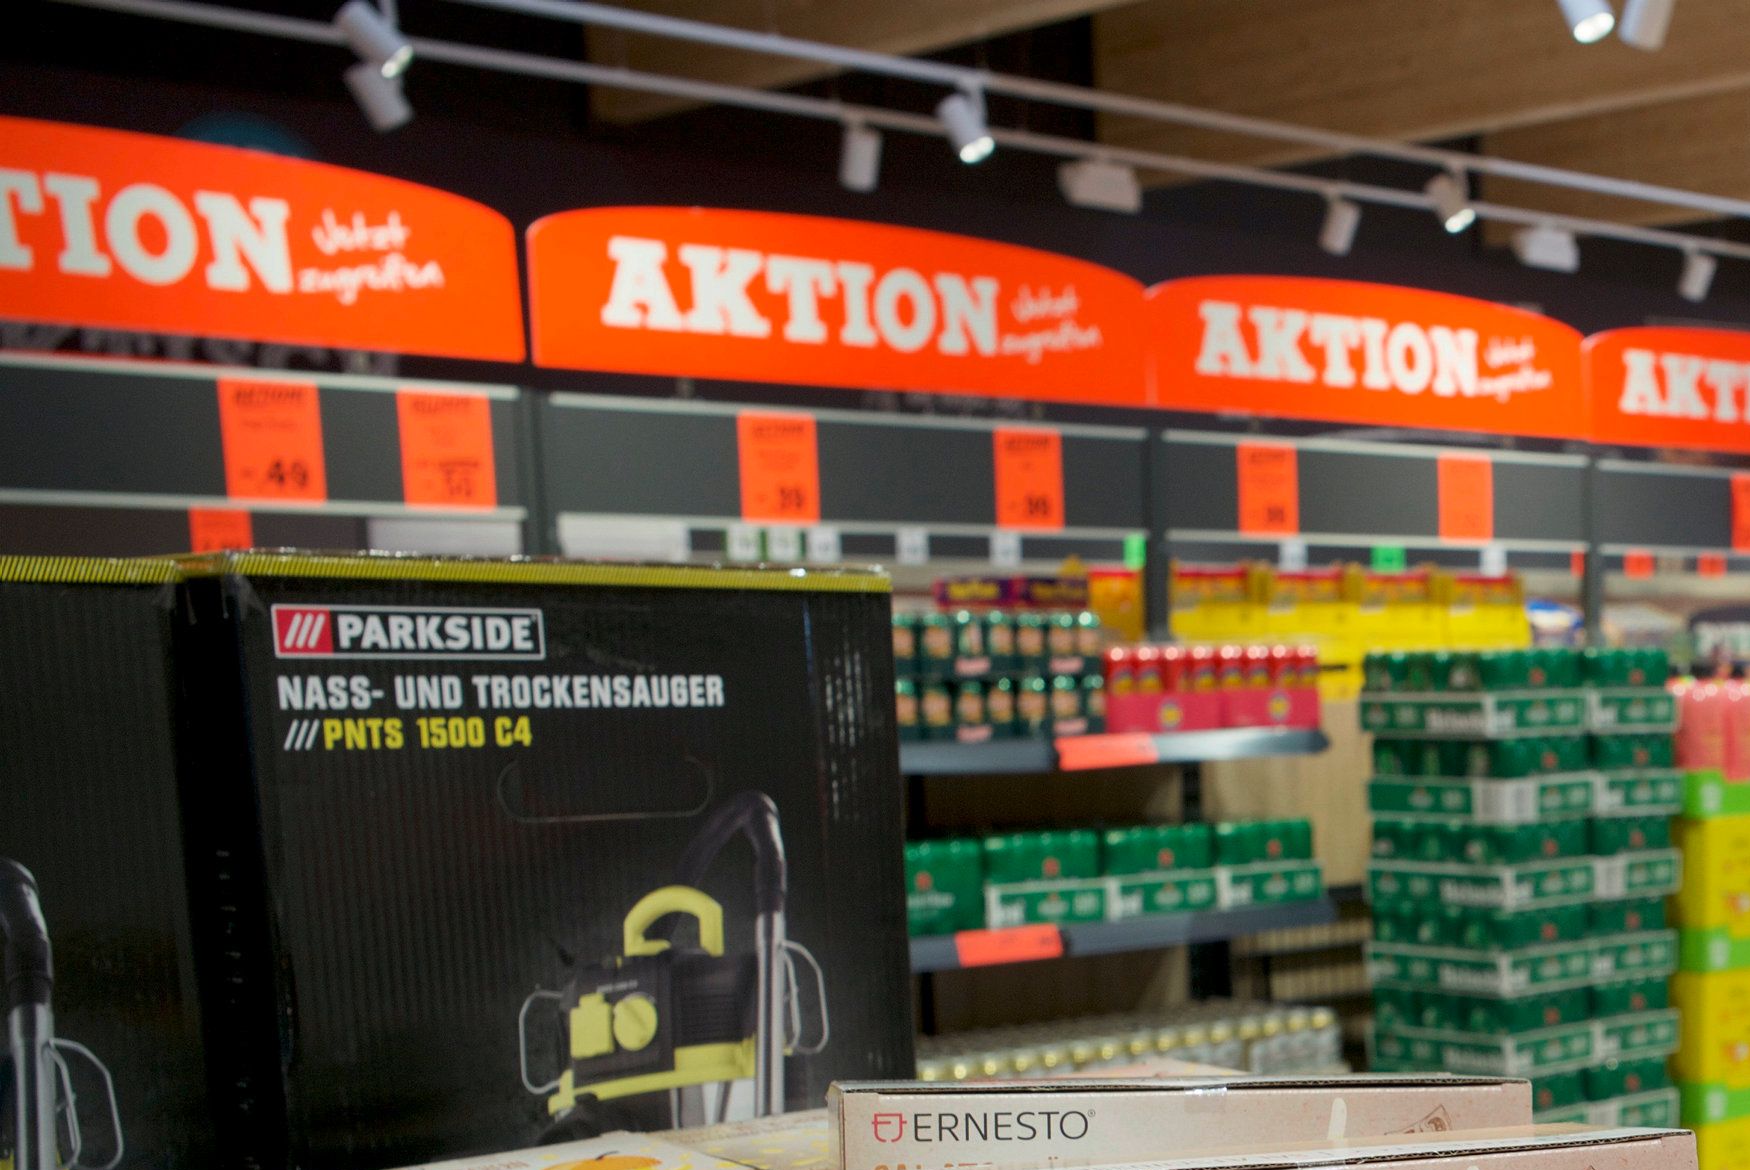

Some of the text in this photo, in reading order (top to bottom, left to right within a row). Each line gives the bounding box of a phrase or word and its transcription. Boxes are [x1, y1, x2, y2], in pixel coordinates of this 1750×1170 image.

[601, 236, 999, 356] AKTION
[1196, 302, 1479, 396] AKTION
[337, 613, 534, 652] PARKSIDE
[278, 675, 724, 710] NASS- UND TROCKENSAUGER
[324, 717, 533, 750] PNTS 1500 C4
[914, 1110, 1090, 1143] ERNESTO
